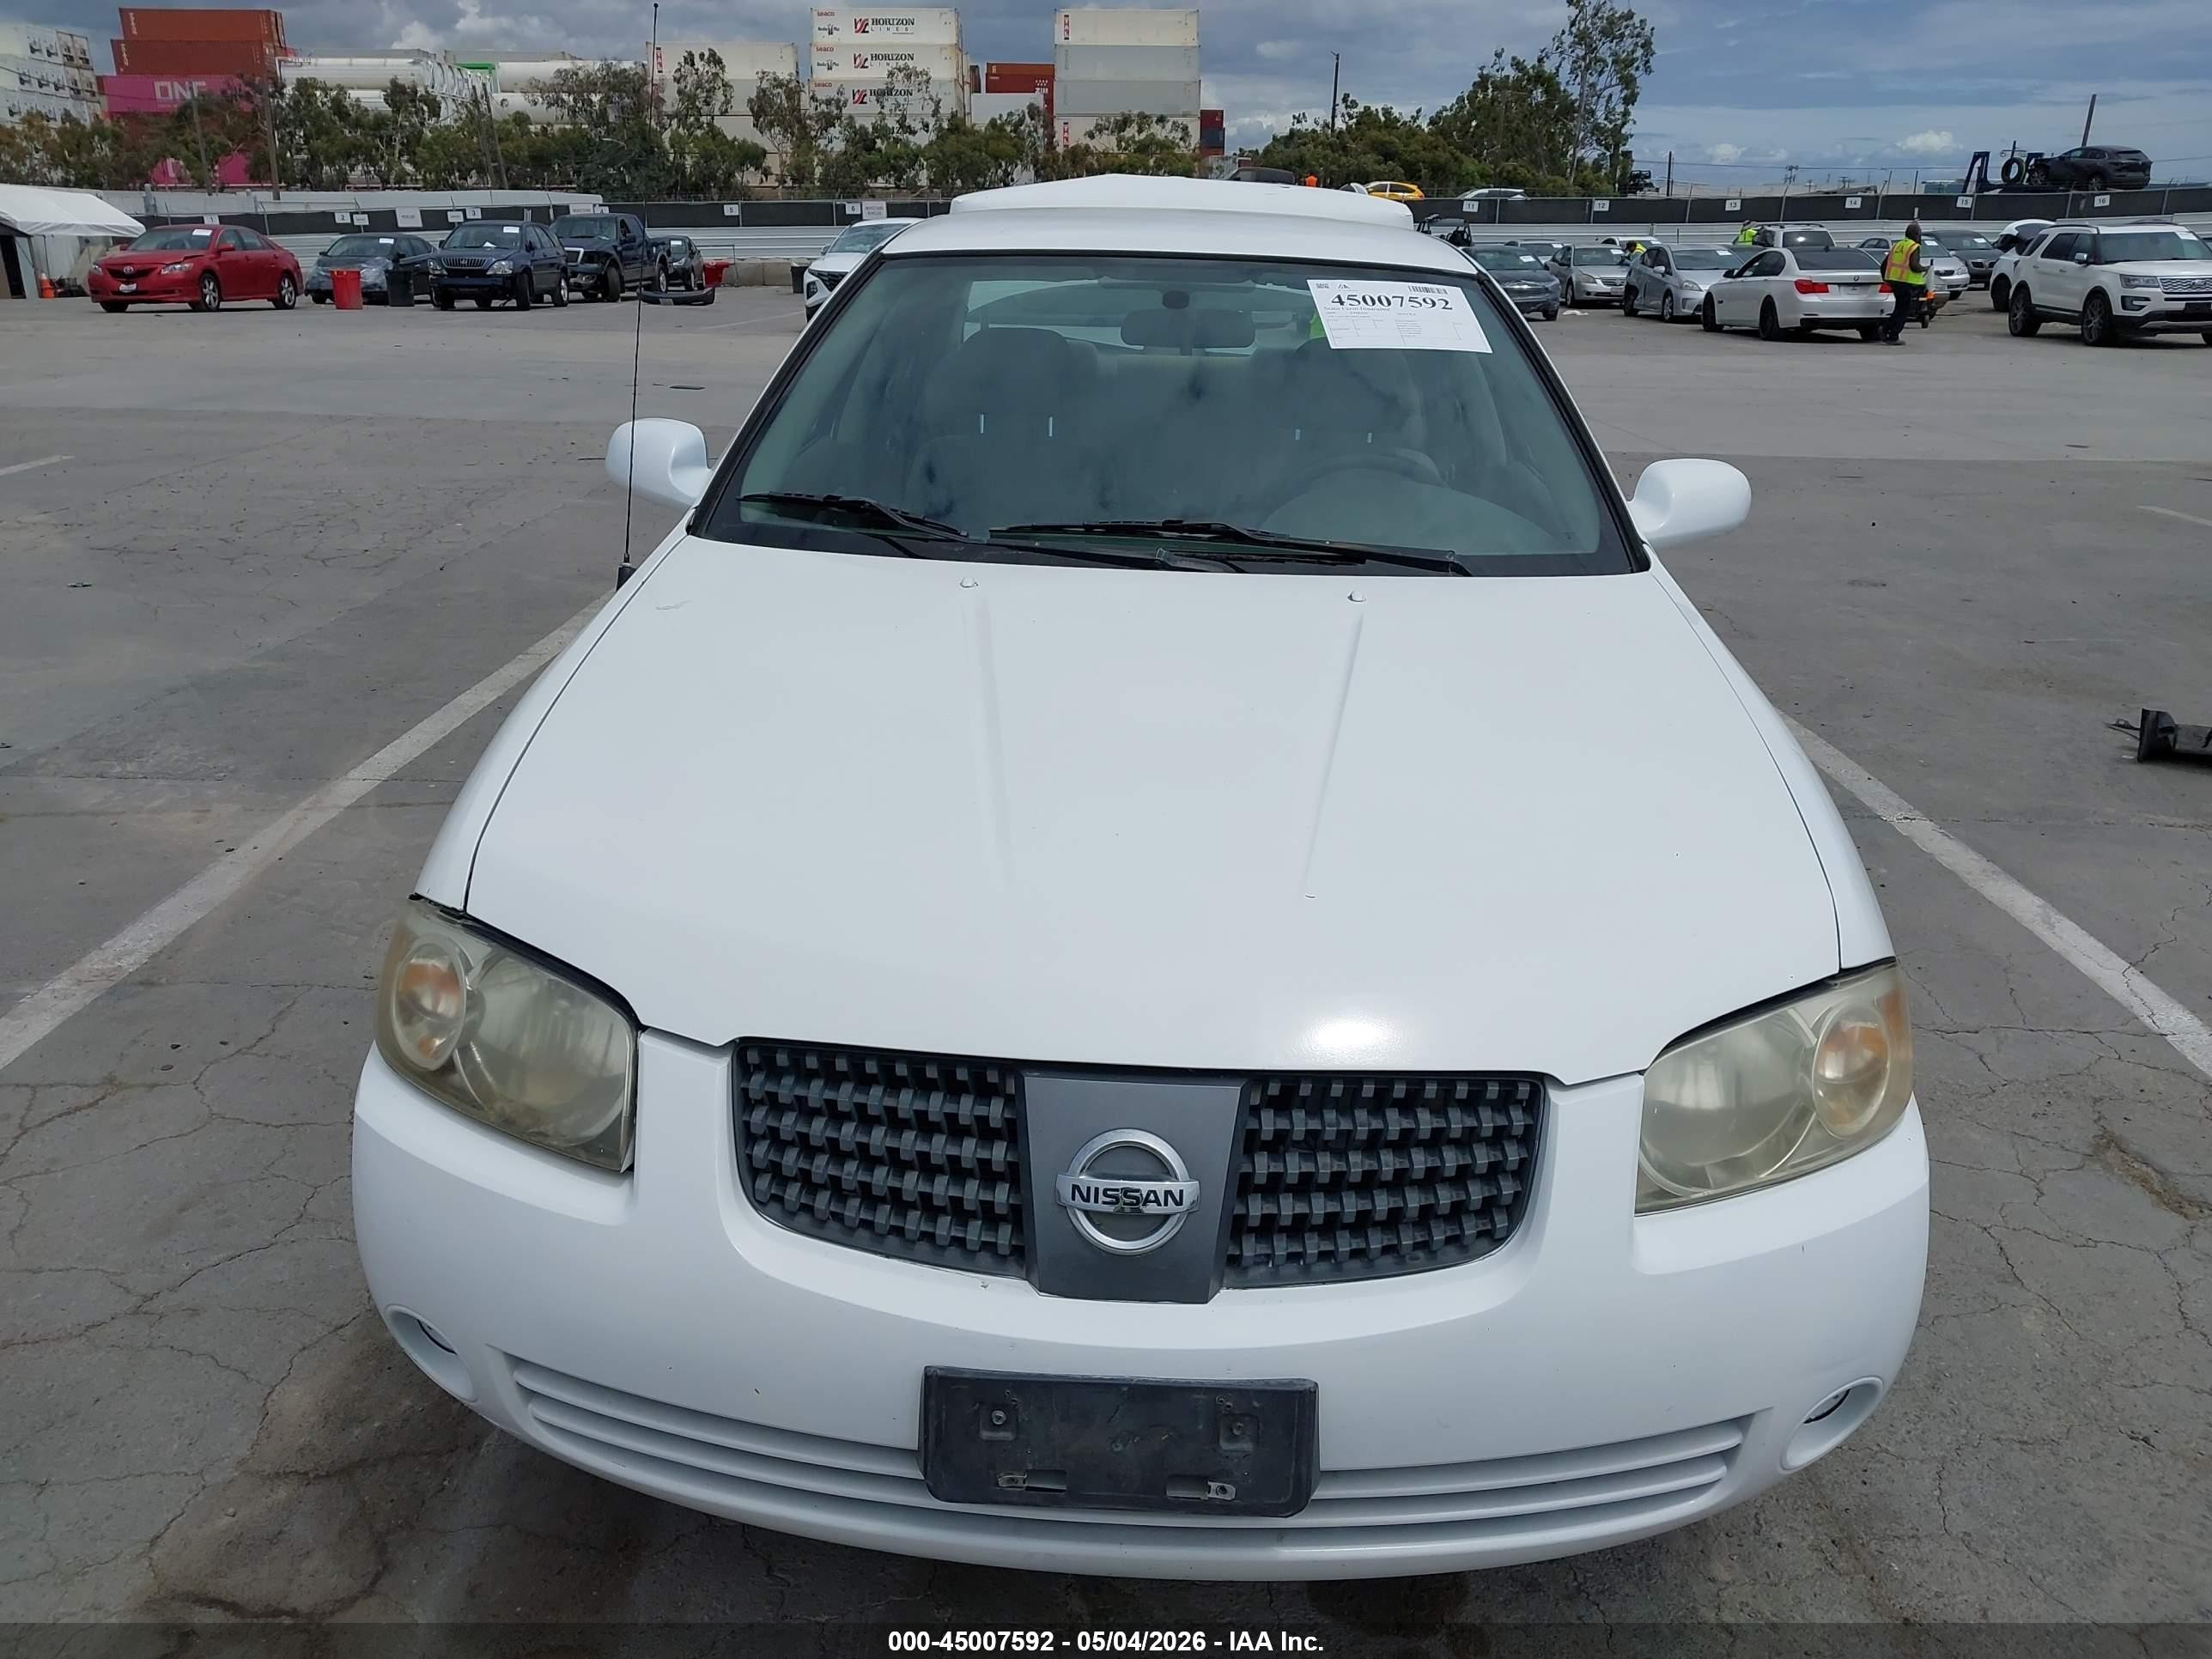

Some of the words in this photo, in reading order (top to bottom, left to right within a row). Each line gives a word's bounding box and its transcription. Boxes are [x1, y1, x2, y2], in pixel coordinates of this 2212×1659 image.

[870, 88, 913, 97] HORIZON
[1331, 294, 1453, 310] 45007592
[1071, 1184, 1184, 1207] NISSAN
